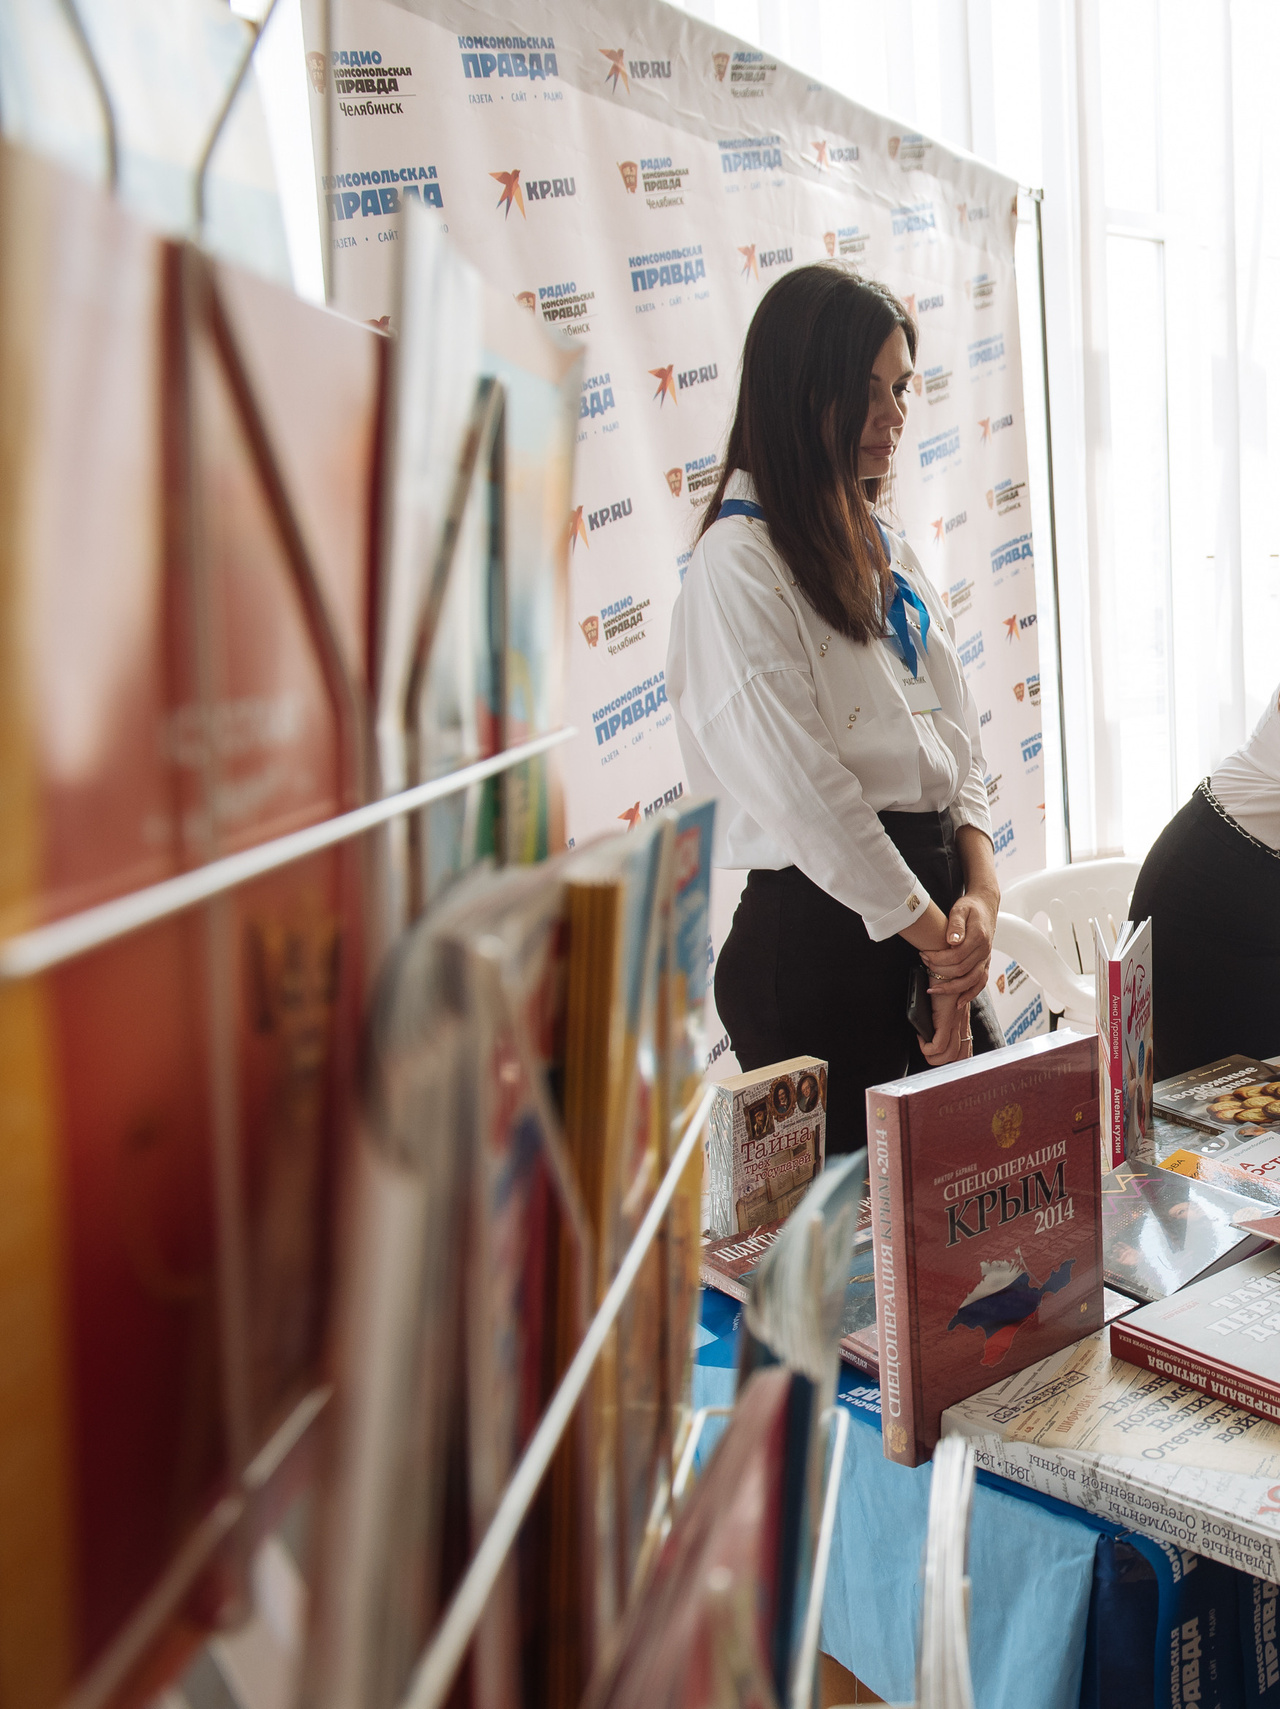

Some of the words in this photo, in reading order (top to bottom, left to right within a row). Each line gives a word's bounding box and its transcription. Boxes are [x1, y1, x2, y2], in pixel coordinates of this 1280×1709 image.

[457, 36, 555, 51] КОМСОМОЛЬСКАЯ
[332, 51, 382, 66] РАДИО
[461, 52, 559, 81] ПРАВДА
[629, 61, 672, 79] KP.RU
[333, 67, 412, 78] КОМСОМОЛЬСКАЯ
[336, 78, 399, 95] ПРАВДА
[469, 94, 493, 104] ГАЗЕТА
[511, 91, 527, 102] САЙТ
[339, 101, 404, 117] Челябинск
[640, 157, 672, 171] РАДИО
[721, 149, 782, 174] ПРАВДА
[829, 147, 859, 161] KP.RU
[321, 166, 438, 190] КОМСОМОЛЬСКАЯ
[526, 178, 576, 201] KP.RU
[643, 178, 682, 192] ПРАВДА
[628, 244, 703, 268] КОМСОМОЛЬСКАЯ
[759, 247, 794, 269] KP.RU
[631, 258, 706, 293] ПРАВДА
[539, 282, 577, 299] РАДИО
[541, 291, 595, 310] КОМСОМОЛЬСКАЯ
[543, 303, 587, 322] ПРАВДА
[635, 303, 656, 314] ГАЗЕТА
[918, 294, 944, 313] KP.RU
[678, 363, 719, 390] KP.RU
[579, 387, 615, 418] ВДА
[685, 454, 717, 473] РАДИО
[920, 435, 960, 468] ПРАВДА
[588, 498, 633, 531] KP.RU
[945, 511, 967, 534] KP.RU
[991, 542, 1033, 573] ПРАВД
[601, 596, 633, 620] РАДИО
[603, 598, 650, 630] КОМСОМОЛЬСКАЯ
[604, 611, 643, 640] ПРАВДА
[608, 630, 646, 656] Челябинск
[592, 671, 664, 723] КОМСОМОЛЬСКАЯ
[595, 683, 668, 746] ПРАВДА
[601, 750, 619, 766] ГАЗЕТА
[632, 729, 644, 746] САЙТ
[644, 782, 684, 820] KP.RU
[1112, 995, 1120, 1016] Анна
[1111, 1018, 1122, 1059] Гуралевич
[1160, 1067, 1258, 1101] Творожные
[1114, 1088, 1122, 1123] Ангелы
[741, 1126, 811, 1164] Тайна
[1113, 1125, 1121, 1154] кухни
[744, 1158, 771, 1175] трех
[755, 1151, 812, 1182] государей
[943, 1140, 1066, 1201] СПЕЦОПЕРАЦИЯ
[934, 1173, 953, 1186] ВИКТОР
[945, 1160, 1067, 1248] КРЫМ
[1035, 1197, 1075, 1235] 2014
[881, 1244, 901, 1418] СПЕЦОПЕРАЦИЯ
[1119, 1334, 1132, 1345] ВЕКА
[1132, 1340, 1156, 1354] ИСТОРИИ
[1156, 1349, 1191, 1368] ЗАГАДОЧНОЙ
[1147, 1355, 1208, 1389] ДЯТЛОВА
[1191, 1363, 1211, 1377] САМОЙ
[1216, 1373, 1238, 1387] ВЕРСИИ
[1025, 1374, 1080, 1405] секретно
[1237, 1381, 1264, 1397] ГЛАВНЫЕ
[975, 1449, 996, 1467] 194
[1028, 1454, 1077, 1481] войны
[1004, 1461, 1031, 1483] 1941
[1081, 1475, 1197, 1530] Отечественной
[1108, 1501, 1197, 1544] документы
[1202, 1520, 1273, 1559] Великой
[1202, 1536, 1272, 1577] Главные
